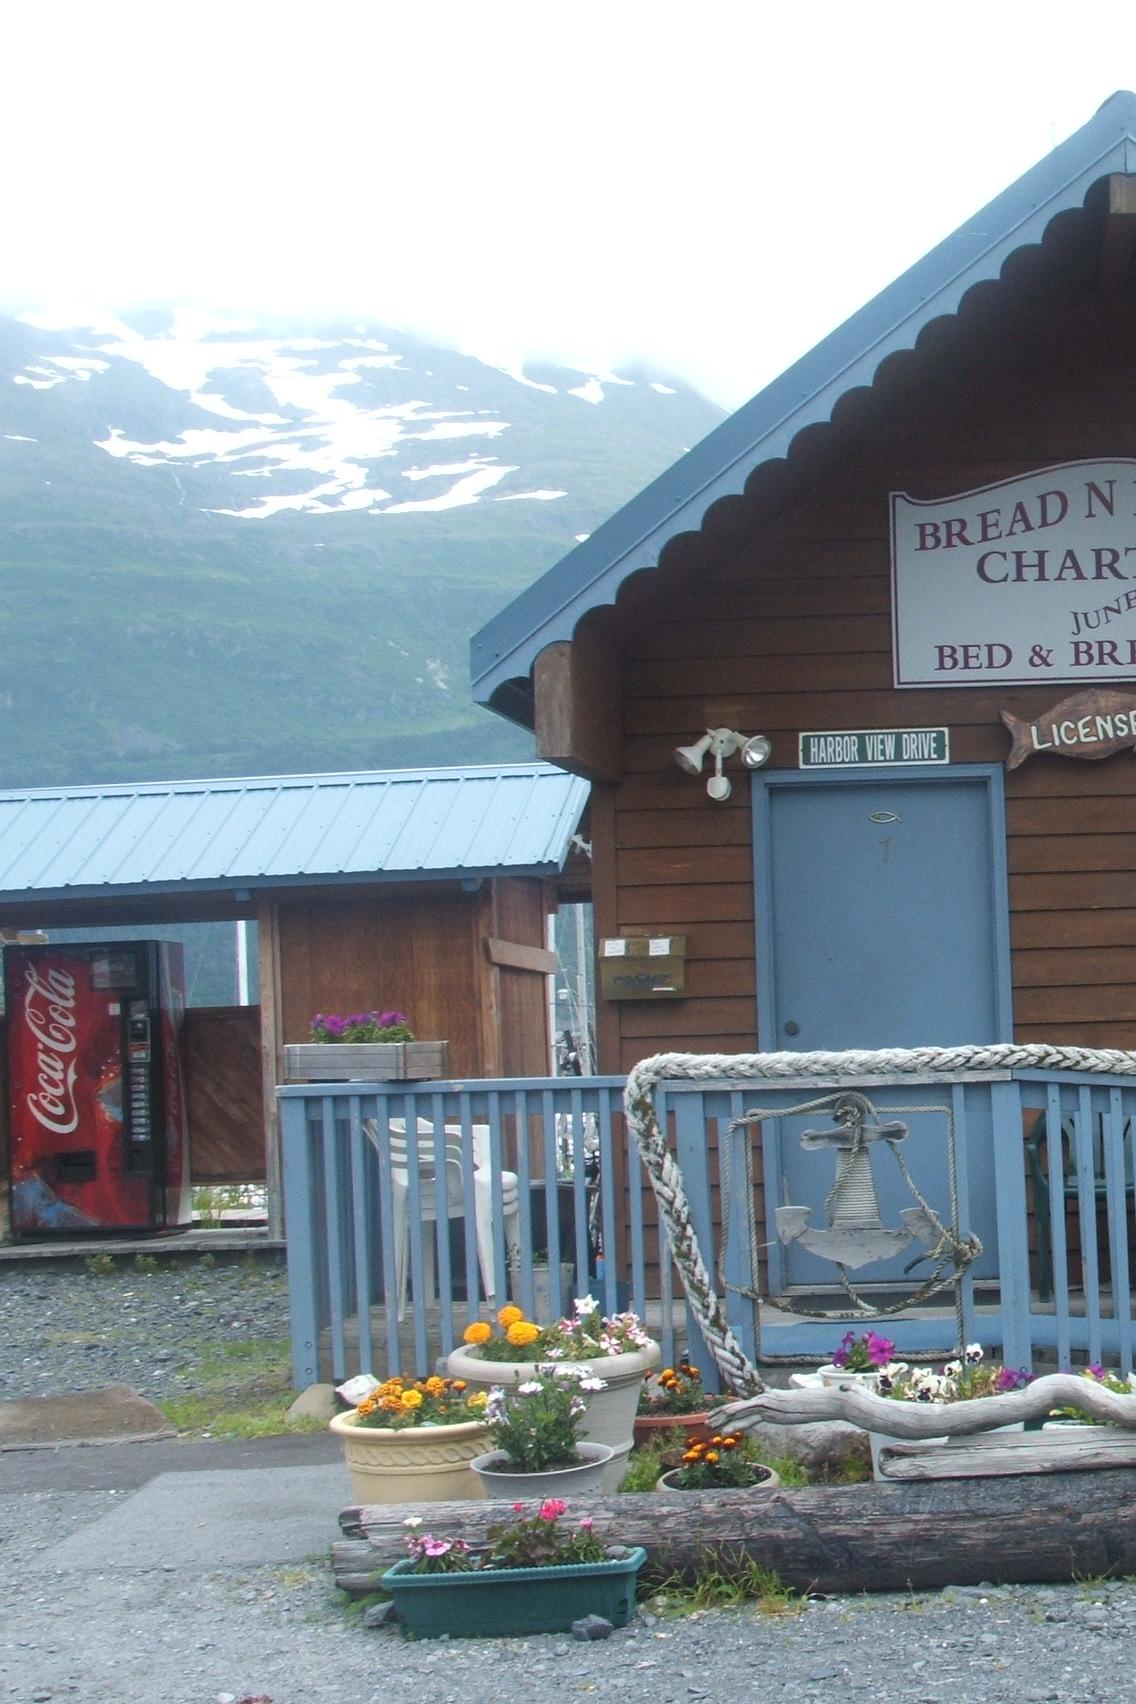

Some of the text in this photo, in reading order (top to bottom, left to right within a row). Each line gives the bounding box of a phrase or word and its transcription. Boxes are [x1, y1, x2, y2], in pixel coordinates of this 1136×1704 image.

[913, 489, 1069, 552] BREAD
[1084, 478, 1118, 518] N
[933, 643, 1013, 672] BED
[1028, 644, 1054, 669] &
[810, 732, 938, 763] HARBOR VIEW DRIVE
